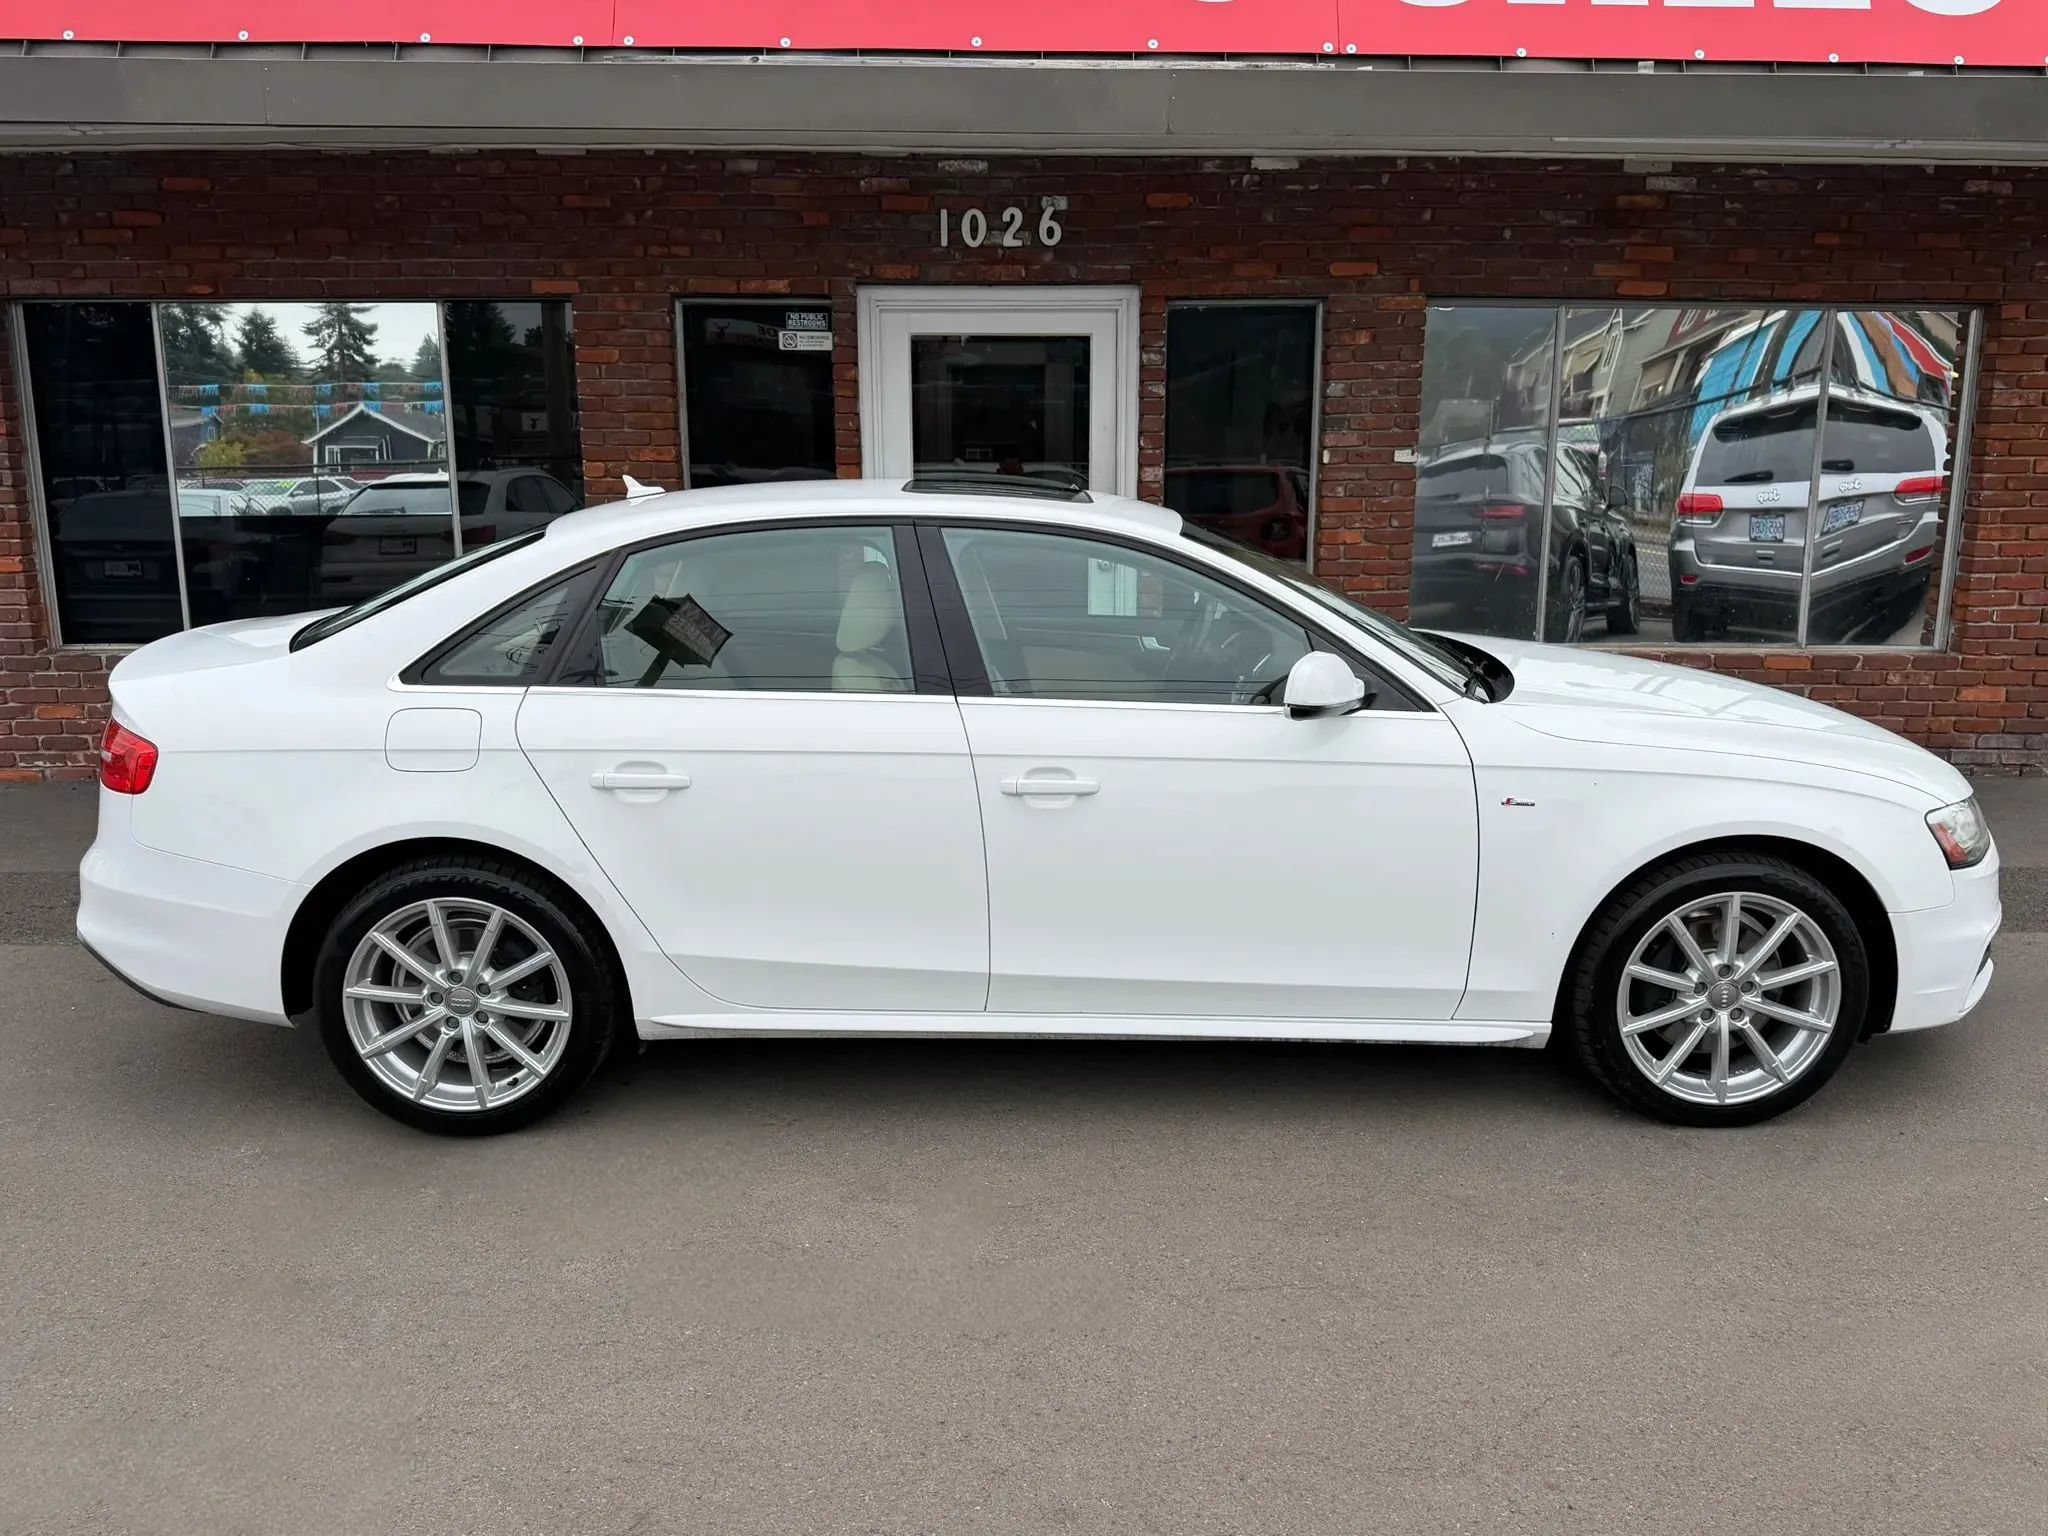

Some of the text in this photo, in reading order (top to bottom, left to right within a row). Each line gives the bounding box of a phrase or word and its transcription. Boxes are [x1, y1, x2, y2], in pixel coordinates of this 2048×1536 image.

[940, 206, 1062, 248] 1026
[790, 312, 824, 320] NO PUBLIC
[788, 319, 826, 327] RESTROOMS
